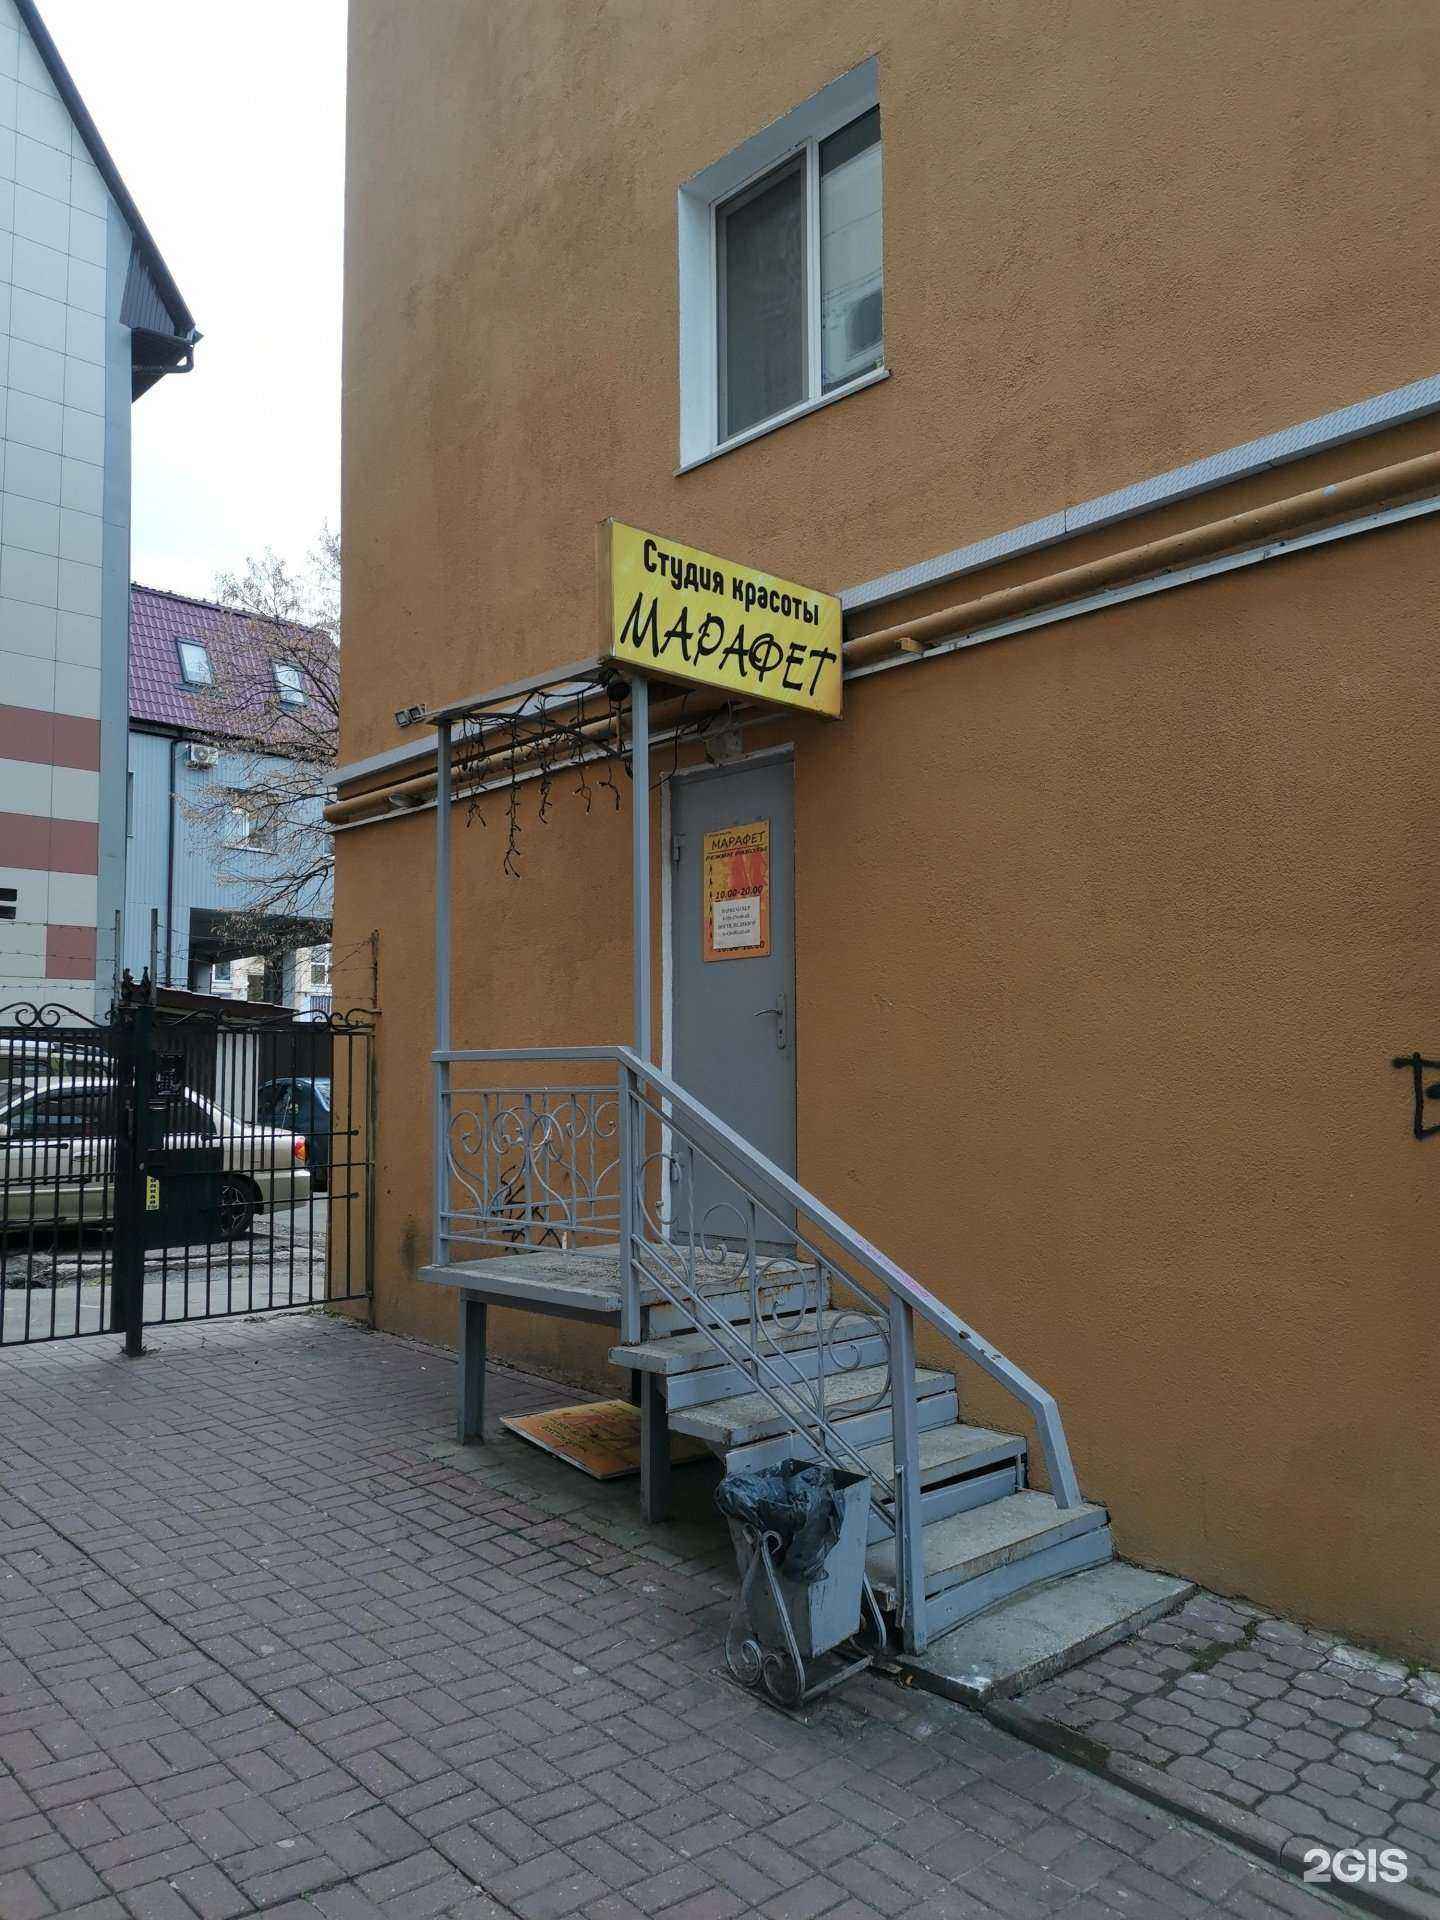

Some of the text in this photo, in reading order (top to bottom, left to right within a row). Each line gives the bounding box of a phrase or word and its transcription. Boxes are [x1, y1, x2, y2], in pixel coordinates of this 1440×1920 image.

[643, 538, 819, 626] Студия красоты
[619, 591, 837, 697] МАРАФЕТ
[711, 830, 766, 850] МАРАФЕТ
